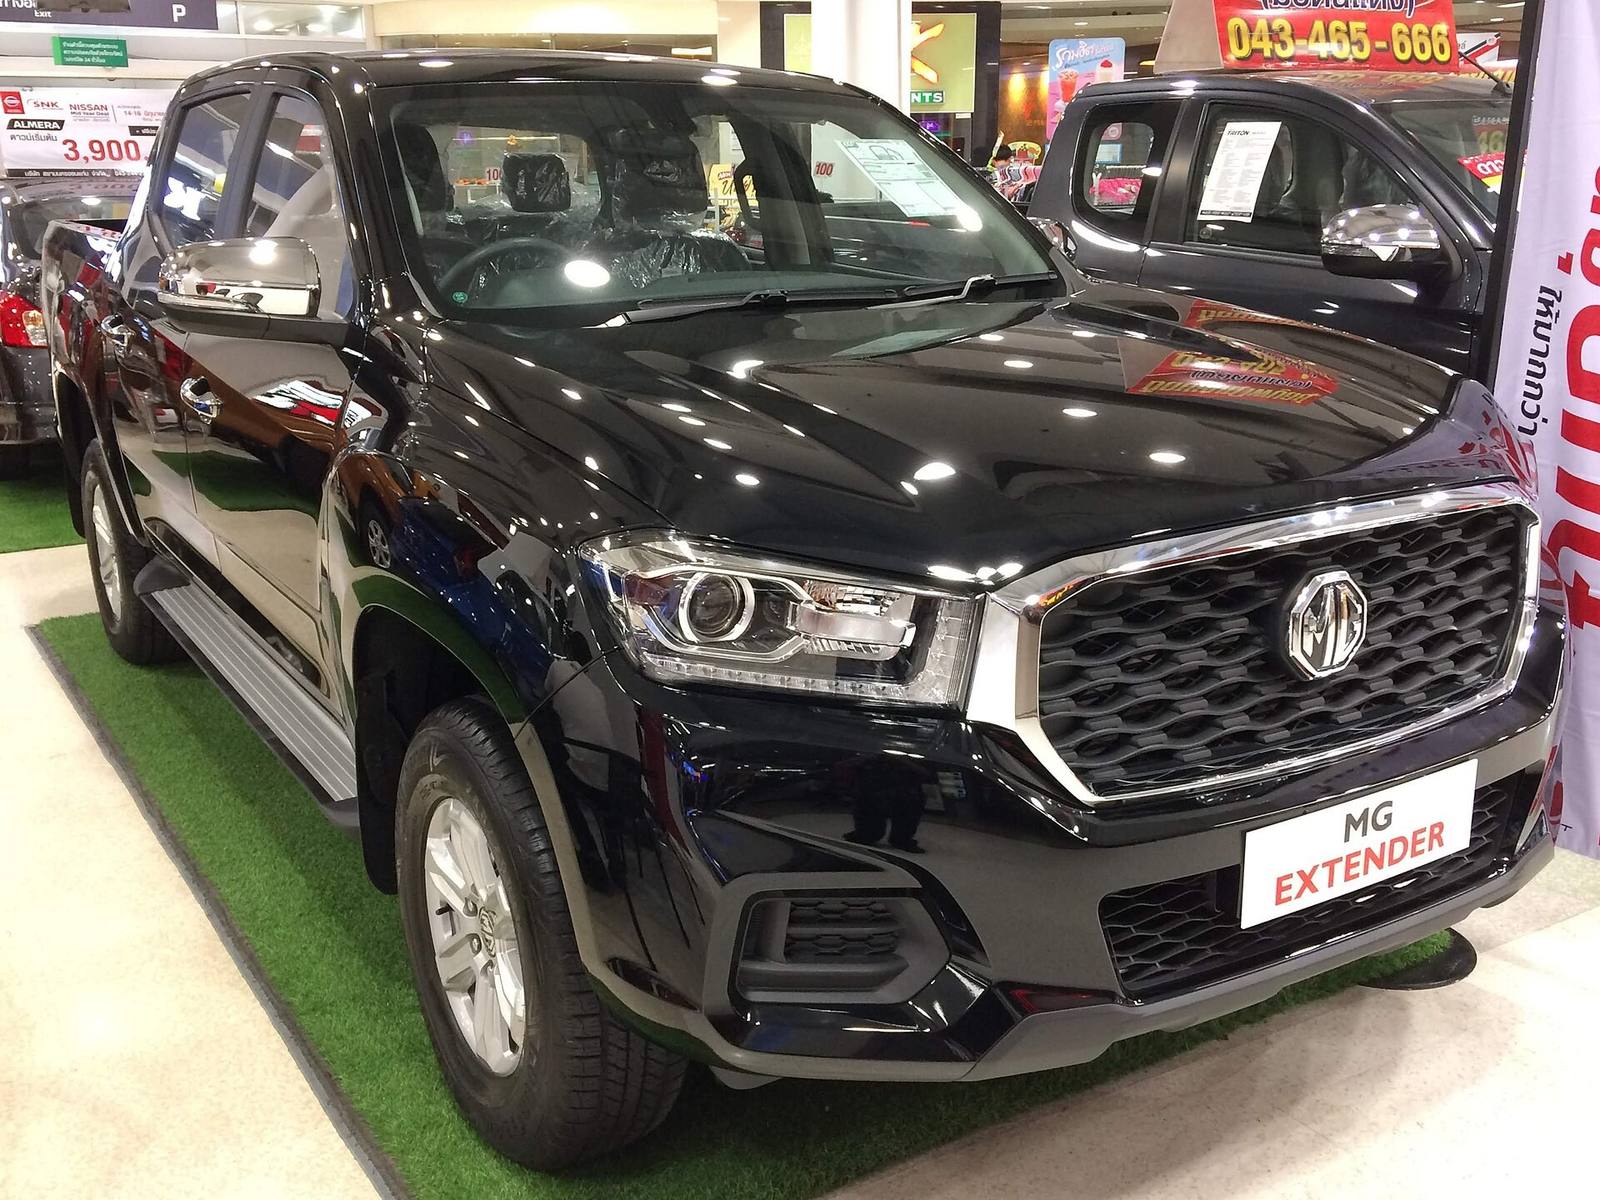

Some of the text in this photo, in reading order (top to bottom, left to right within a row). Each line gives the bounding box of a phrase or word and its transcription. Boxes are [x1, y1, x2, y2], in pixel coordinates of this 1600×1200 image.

[172, 4, 186, 23] P
[69, 103, 108, 111] NISSAN
[13, 121, 61, 130] ALMERA
[815, 163, 833, 176] 100
[1517, 285, 1562, 436] ให้มากกว่า
[1344, 801, 1393, 843] MG
[1274, 821, 1445, 906] EXTENDER
